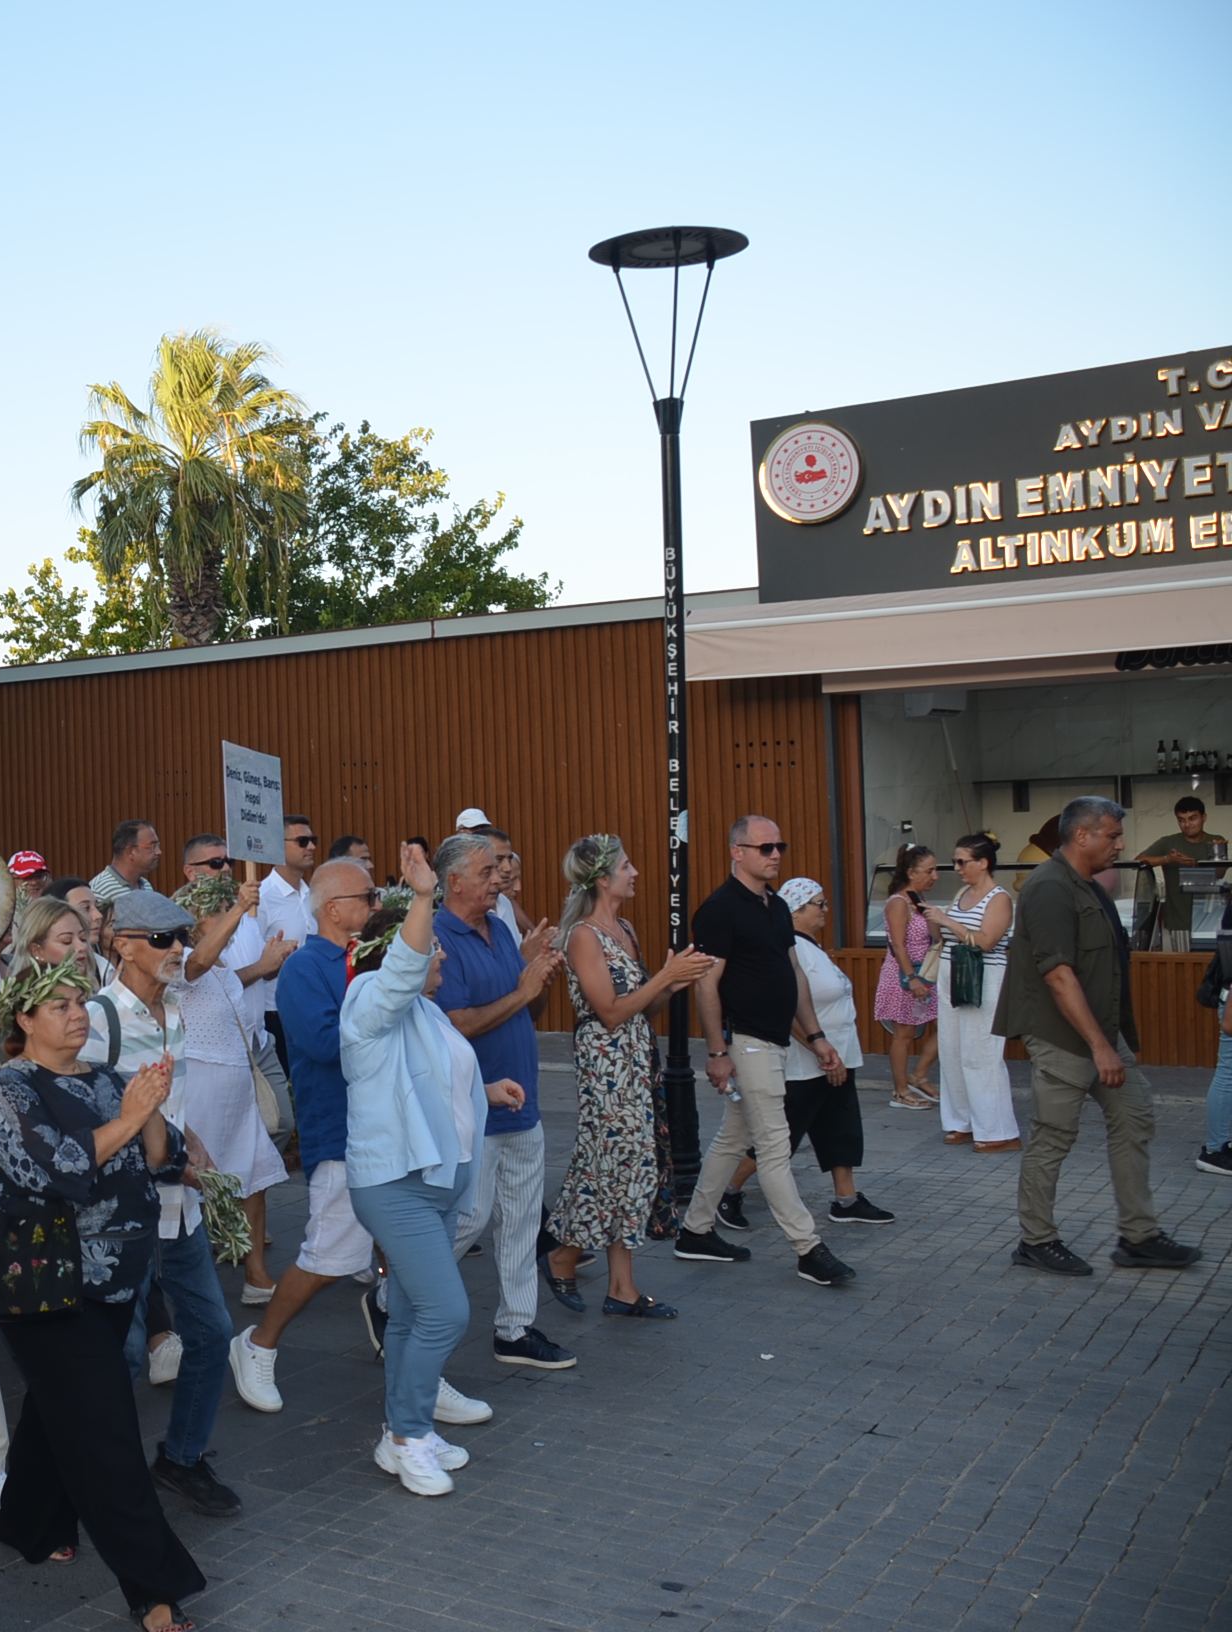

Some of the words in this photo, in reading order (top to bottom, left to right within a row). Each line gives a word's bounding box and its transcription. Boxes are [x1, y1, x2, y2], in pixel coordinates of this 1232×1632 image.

[1053, 407, 1183, 451] AYDIN
[863, 481, 1002, 535] AYDIN
[950, 517, 1174, 573] ALTINKUM
[665, 547, 680, 734] BÜYÜKŞEHİR
[669, 759, 681, 945] BELEDİYESİ
